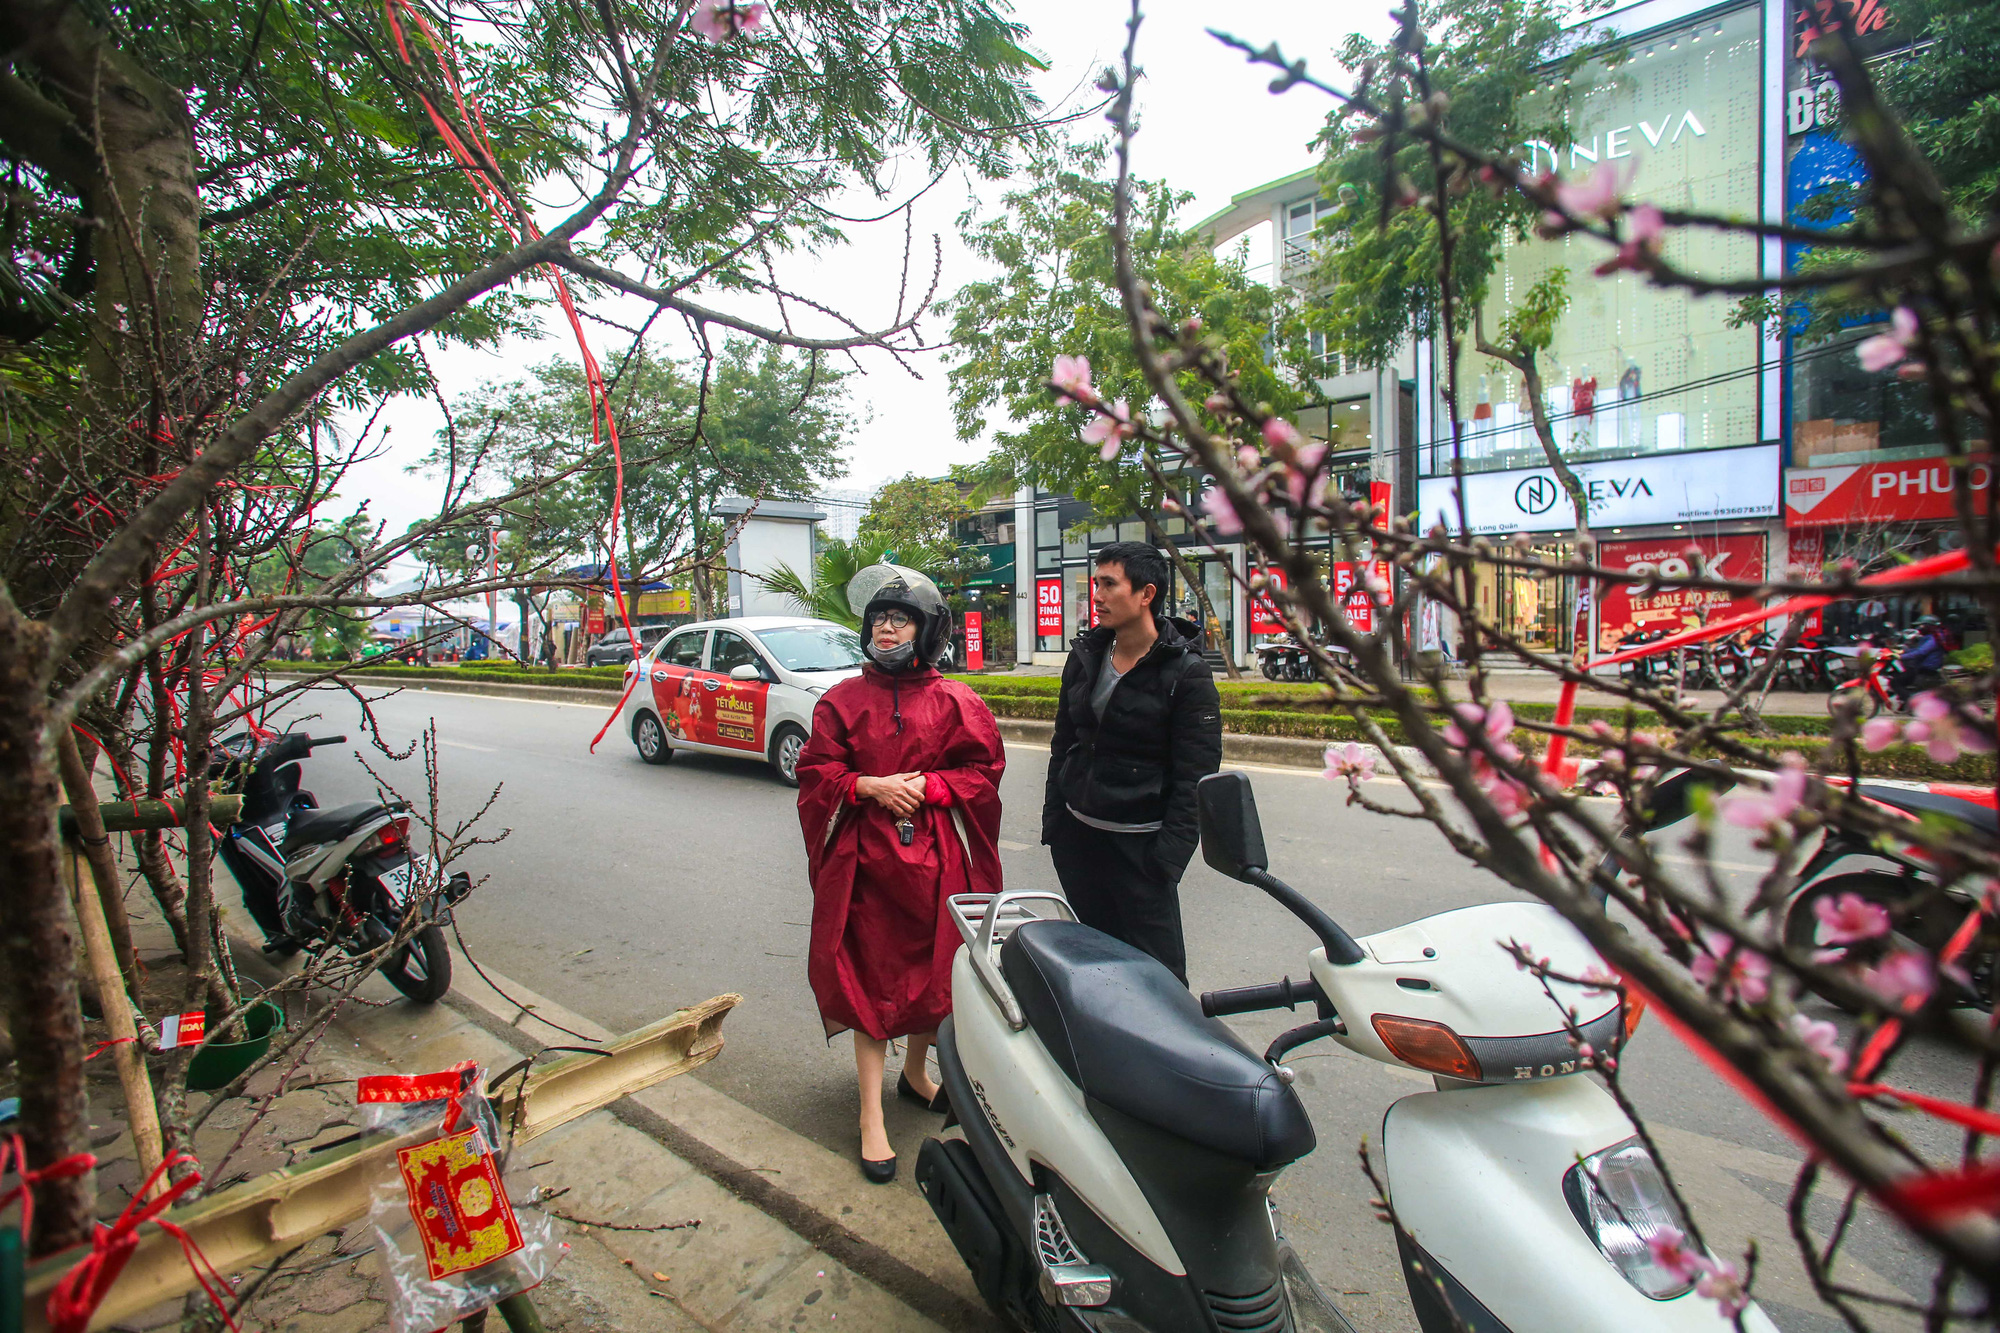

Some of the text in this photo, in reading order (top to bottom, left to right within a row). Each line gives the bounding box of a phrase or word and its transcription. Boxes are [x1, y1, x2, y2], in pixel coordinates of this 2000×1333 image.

[1571, 110, 1706, 169] NEVA
[1565, 477, 1654, 502] EVA
[1016, 591, 1028, 599] 443
[1653, 593, 1682, 608] SALE
[1039, 617, 1060, 626] SALE
[735, 700, 754, 712] SALE
